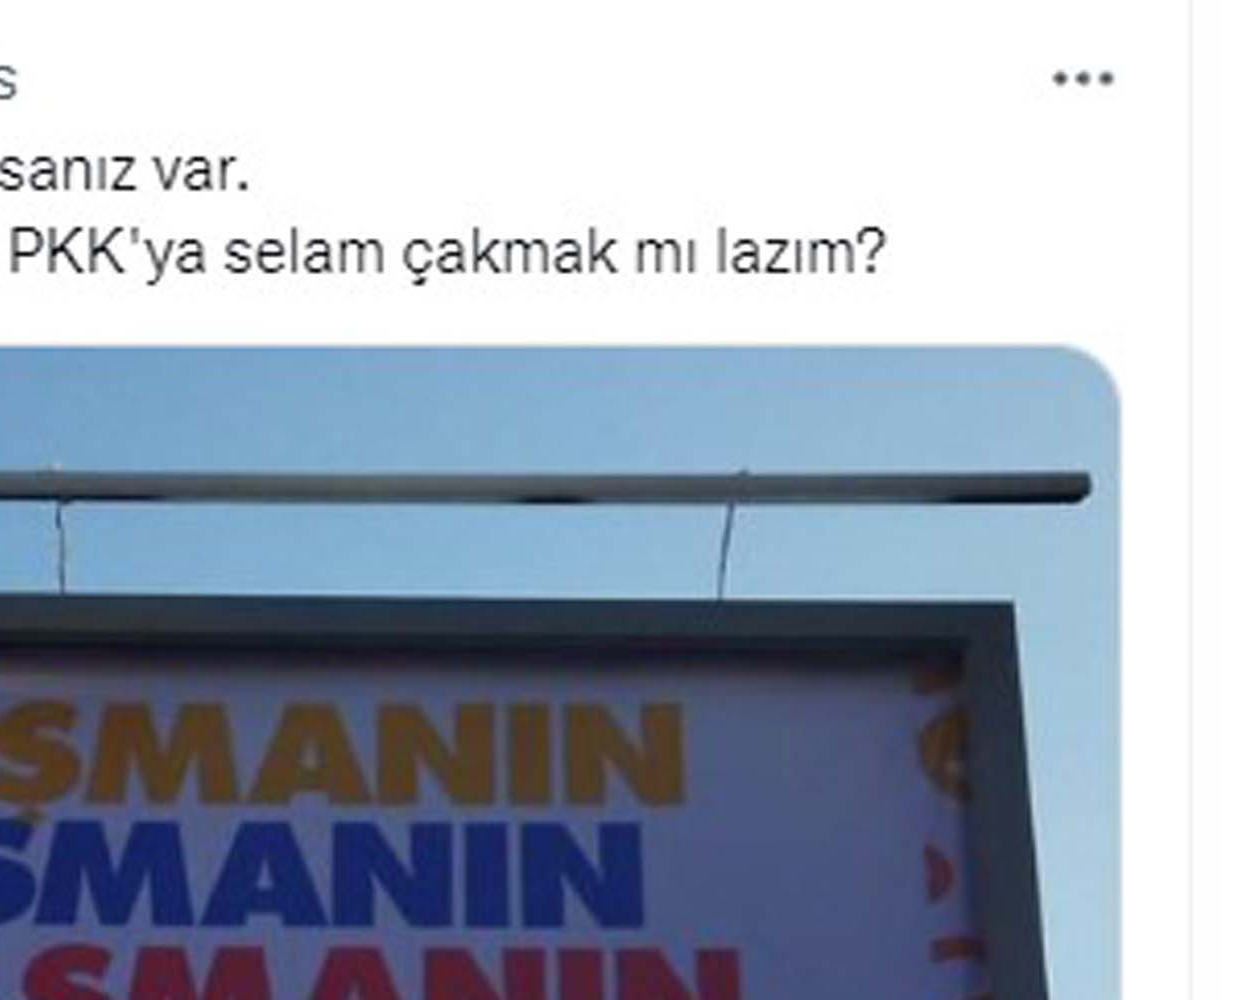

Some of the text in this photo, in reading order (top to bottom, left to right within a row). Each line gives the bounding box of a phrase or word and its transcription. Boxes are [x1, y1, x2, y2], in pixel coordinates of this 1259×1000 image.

[152, 156, 248, 191] var.
[11, 226, 206, 286] PKK'ya
[225, 227, 383, 274] selam
[403, 227, 618, 286] çakmak
[637, 239, 695, 273] mı
[718, 226, 886, 274] lazım?
